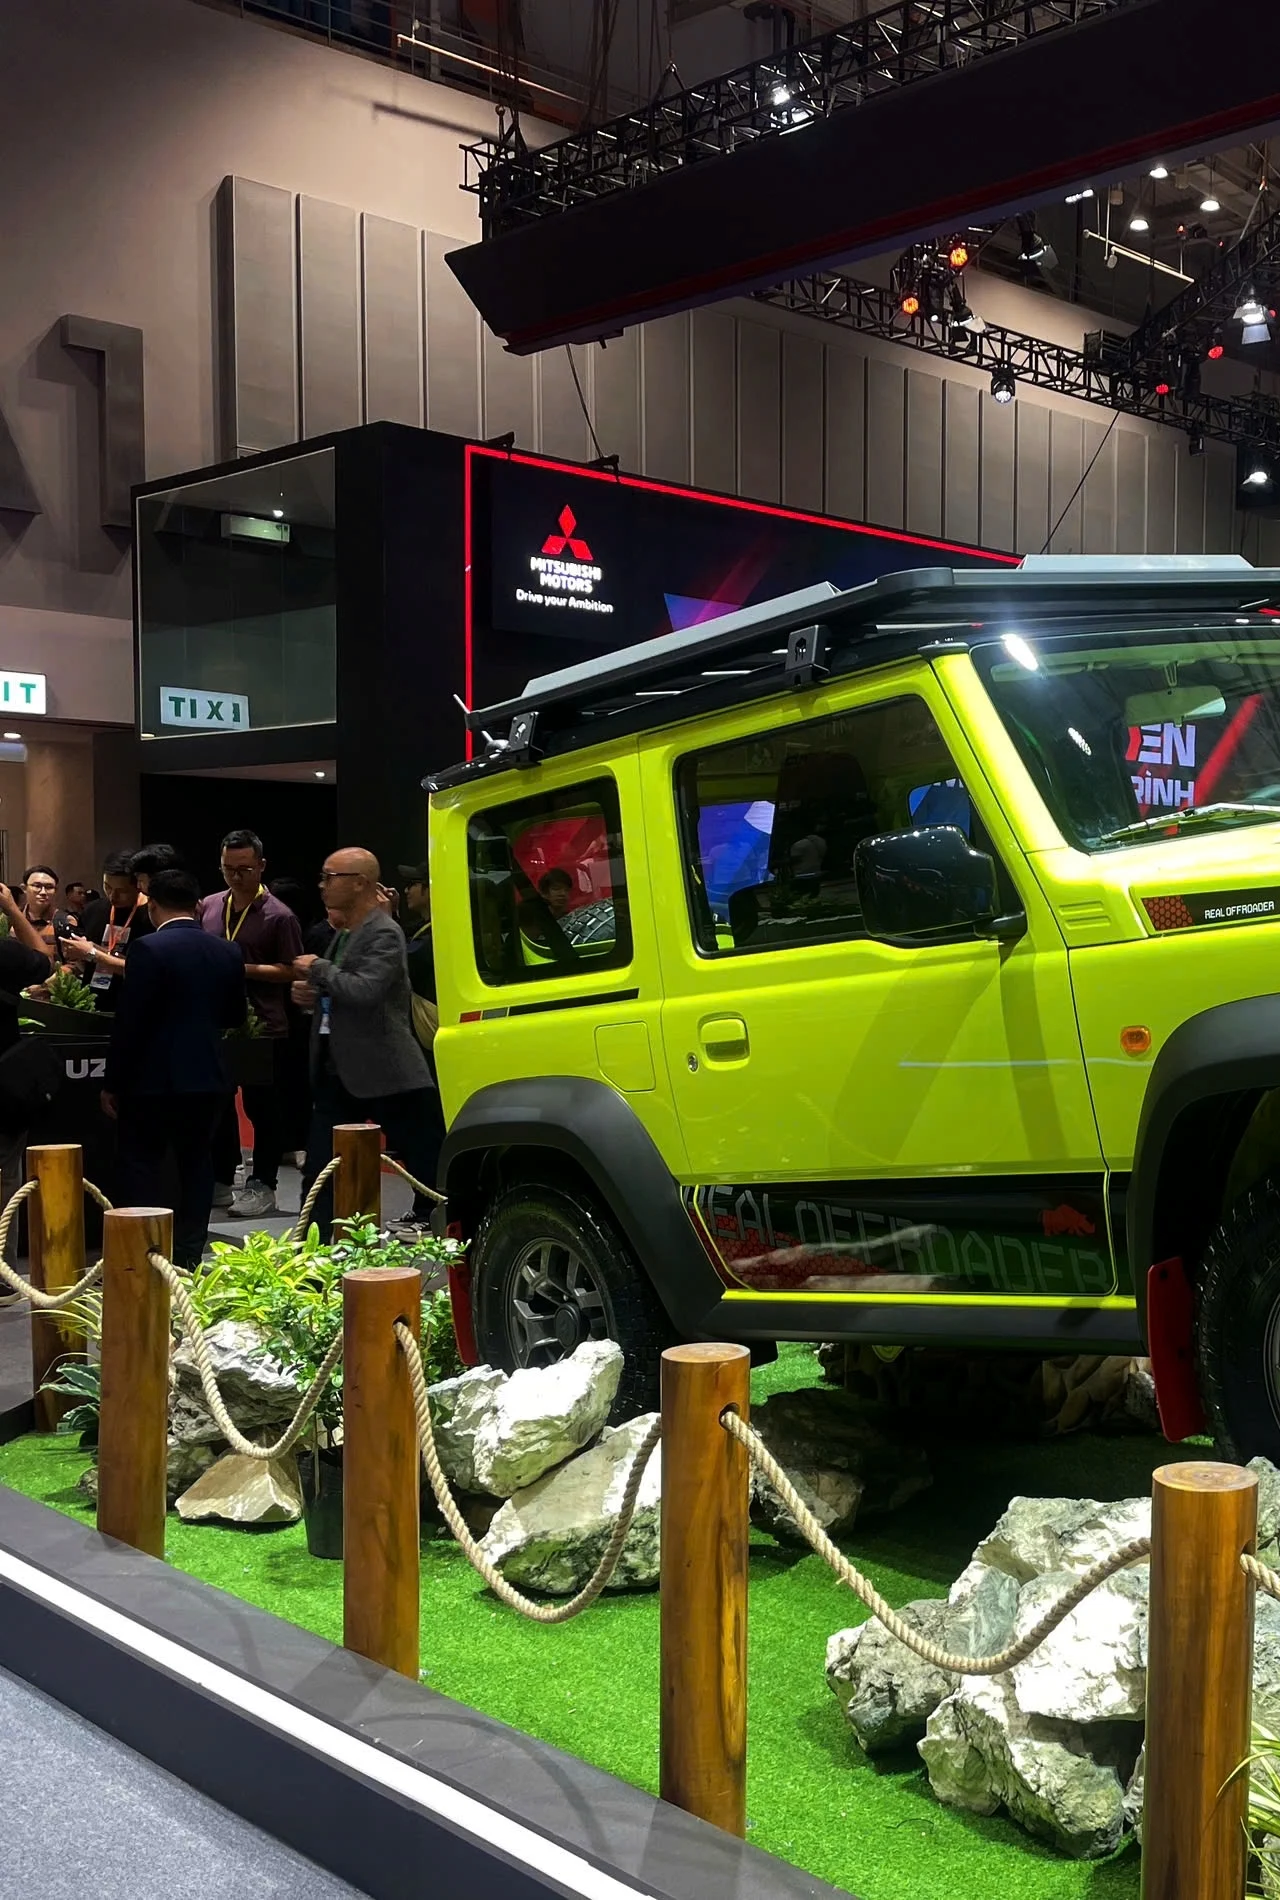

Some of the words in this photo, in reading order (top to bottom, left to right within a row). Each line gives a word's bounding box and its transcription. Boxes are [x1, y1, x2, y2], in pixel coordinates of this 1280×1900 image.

[530, 556, 602, 581] MITSUBISHI
[540, 572, 593, 594] MOTORS
[516, 588, 544, 604] Drive
[544, 594, 568, 607] your
[568, 596, 614, 613] Ambition
[3, 681, 37, 704] IT
[1204, 907, 1226, 920] REAL
[1225, 900, 1275, 917] OFFROADER
